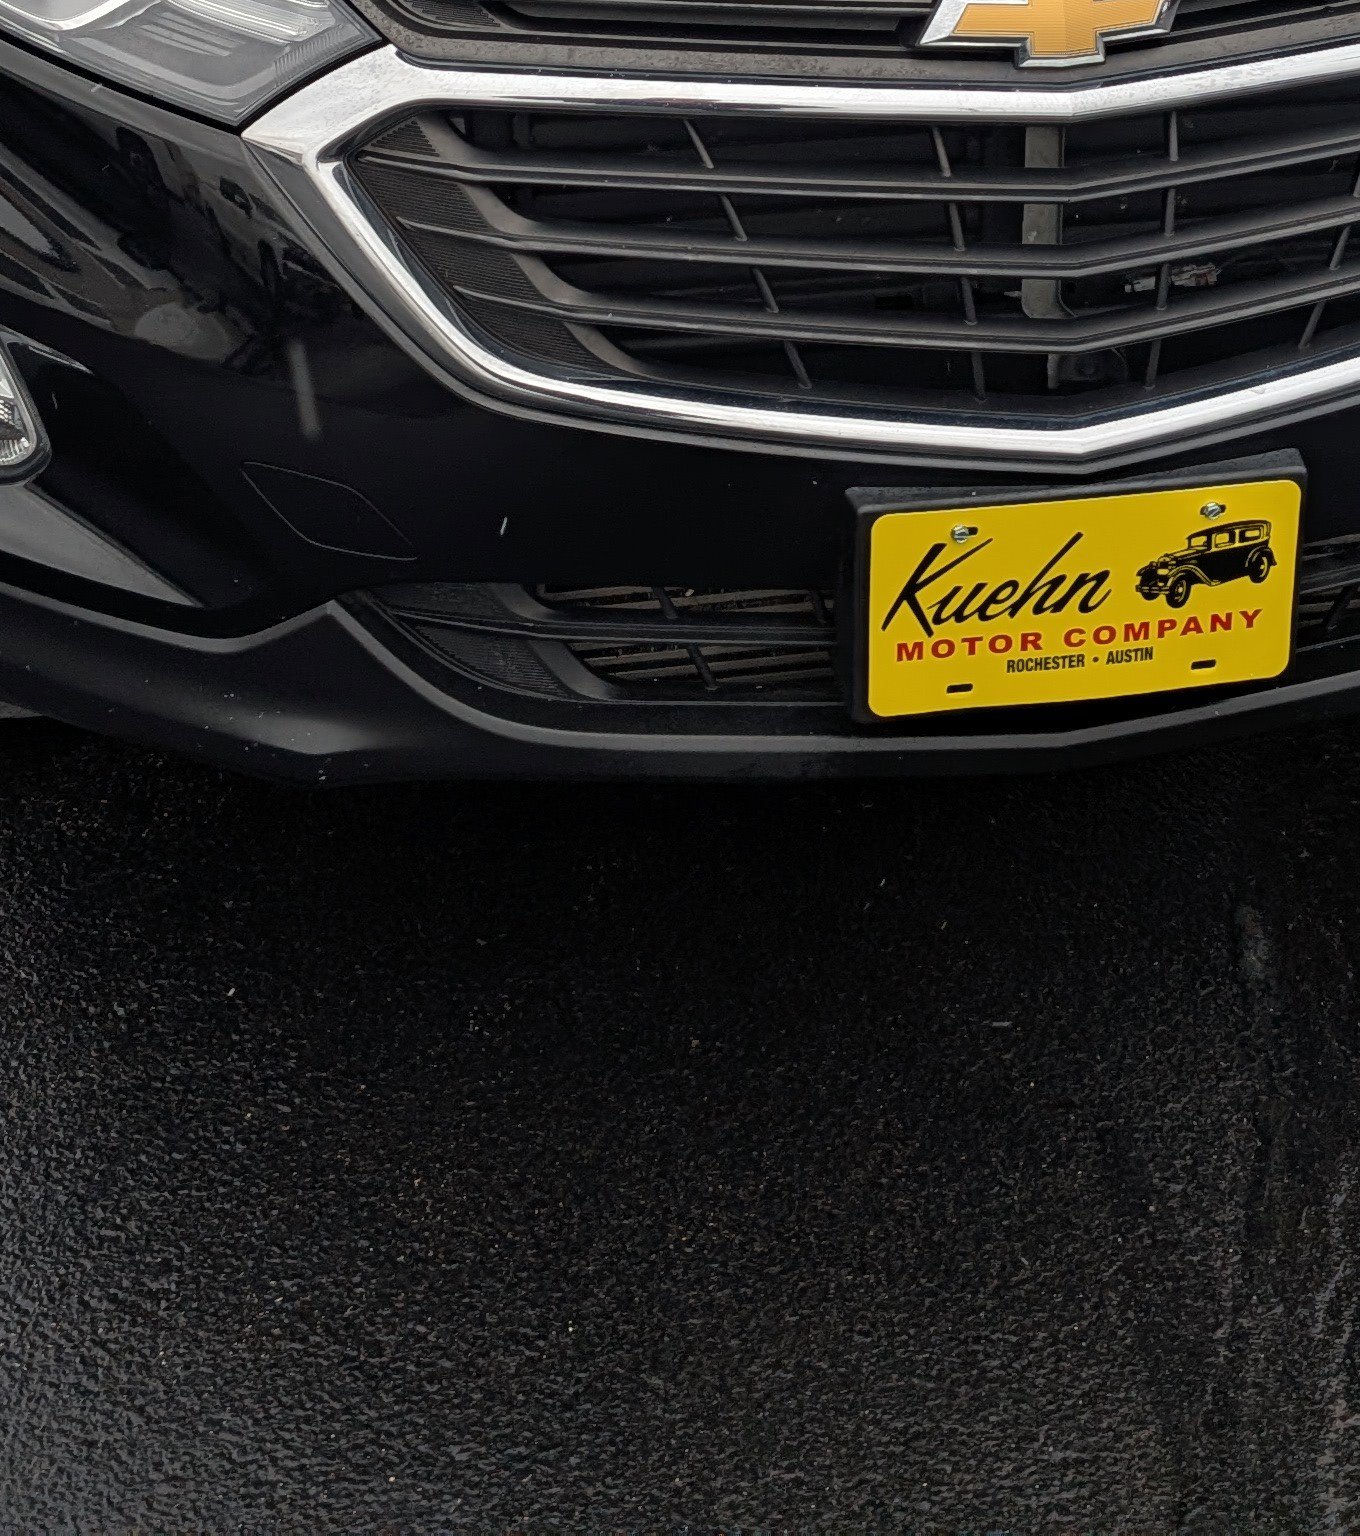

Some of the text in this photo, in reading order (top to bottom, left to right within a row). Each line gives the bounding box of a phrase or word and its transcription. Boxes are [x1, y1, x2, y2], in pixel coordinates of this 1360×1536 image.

[881, 531, 1112, 638] Kuehn
[896, 608, 1264, 662] MOTOR COMPANY
[1006, 646, 1154, 673] ROCHESTER AUSTIN
